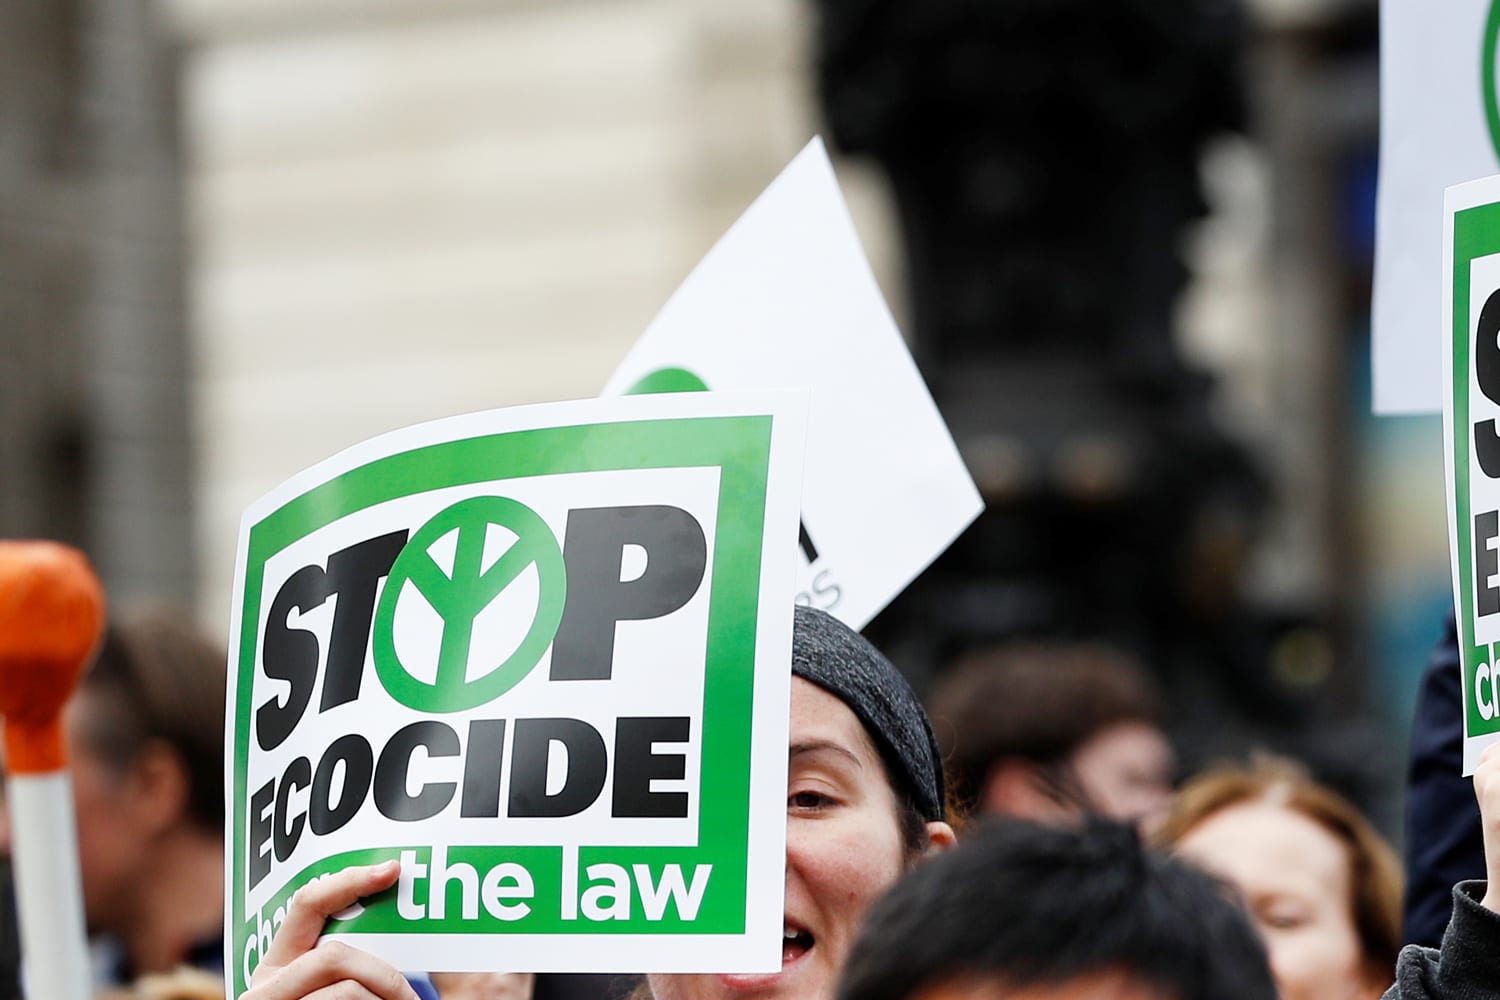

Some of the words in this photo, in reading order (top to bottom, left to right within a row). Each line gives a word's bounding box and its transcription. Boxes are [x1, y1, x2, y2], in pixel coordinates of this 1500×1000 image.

[256, 495, 707, 751] STOP
[249, 716, 691, 892] ECOCIDE
[396, 846, 532, 922] the
[561, 846, 713, 922] law
